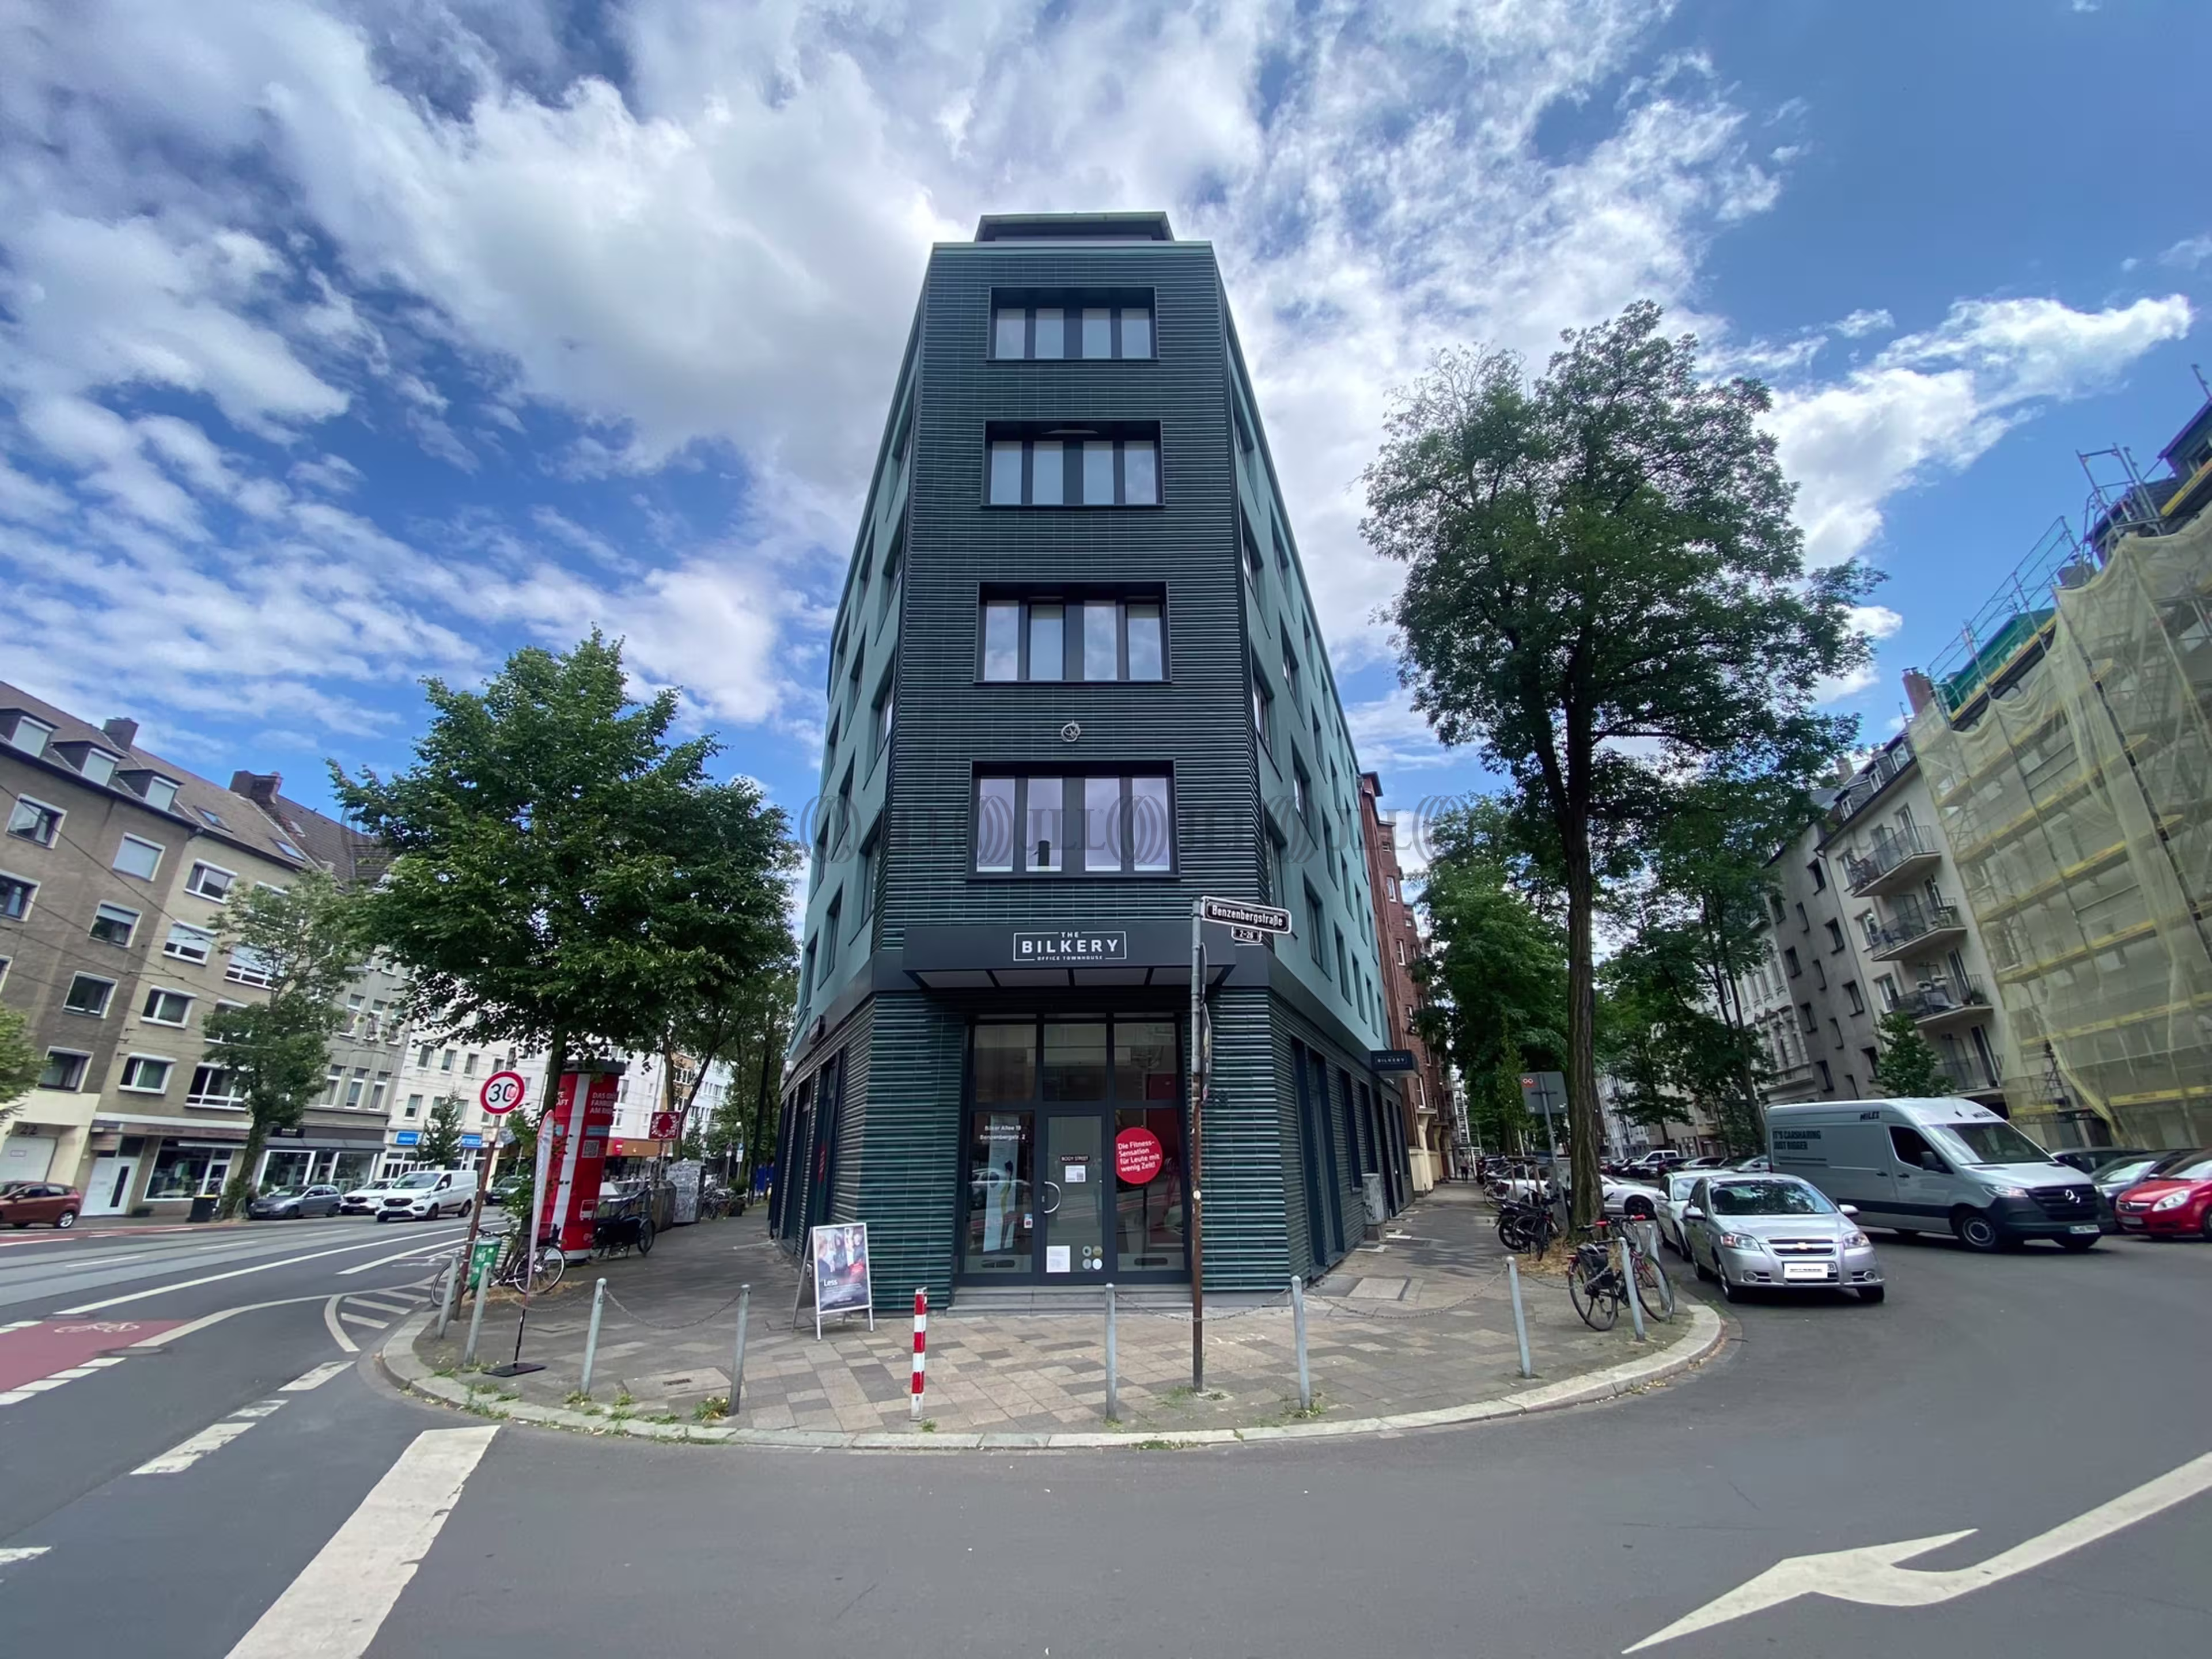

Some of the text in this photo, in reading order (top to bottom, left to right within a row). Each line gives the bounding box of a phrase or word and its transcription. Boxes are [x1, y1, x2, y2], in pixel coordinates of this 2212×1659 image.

[1212, 904, 1283, 926] Benzenbergstraße
[1021, 939, 1118, 953] BILKERY
[1859, 1111, 1879, 1121] MILES
[19, 1124, 37, 1135] 22
[1784, 1131, 1821, 1139] CARSHARING
[1129, 1141, 1155, 1149] Fitness-
[1787, 1141, 1808, 1150] BIGGER
[1119, 1148, 1150, 1157] Sensation
[1130, 1155, 1148, 1164] Leute
[1120, 1164, 1141, 1172] wenig
[824, 1279, 838, 1287] Less
